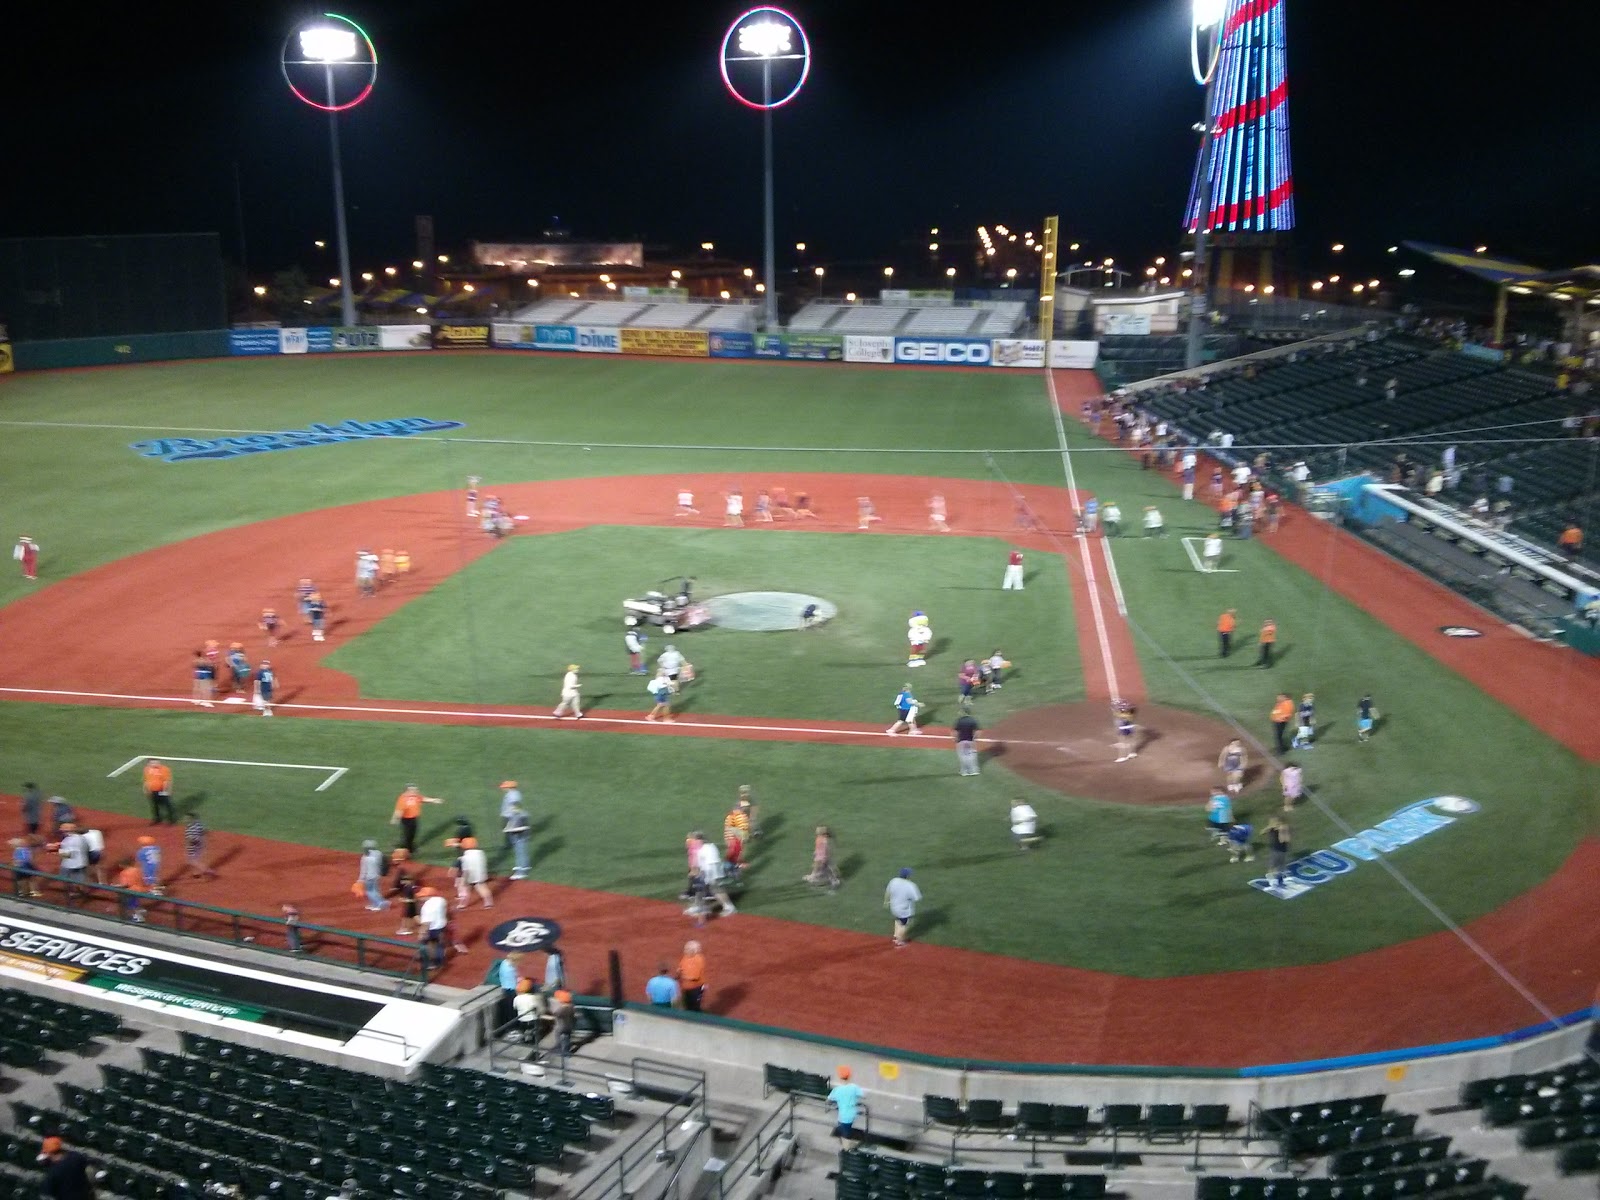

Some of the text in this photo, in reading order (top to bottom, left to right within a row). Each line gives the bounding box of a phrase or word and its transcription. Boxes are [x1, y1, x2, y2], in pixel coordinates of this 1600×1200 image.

[898, 342, 991, 363] GEICO
[129, 417, 464, 463] Brooklyn
[0, 931, 152, 975] SERVICES
